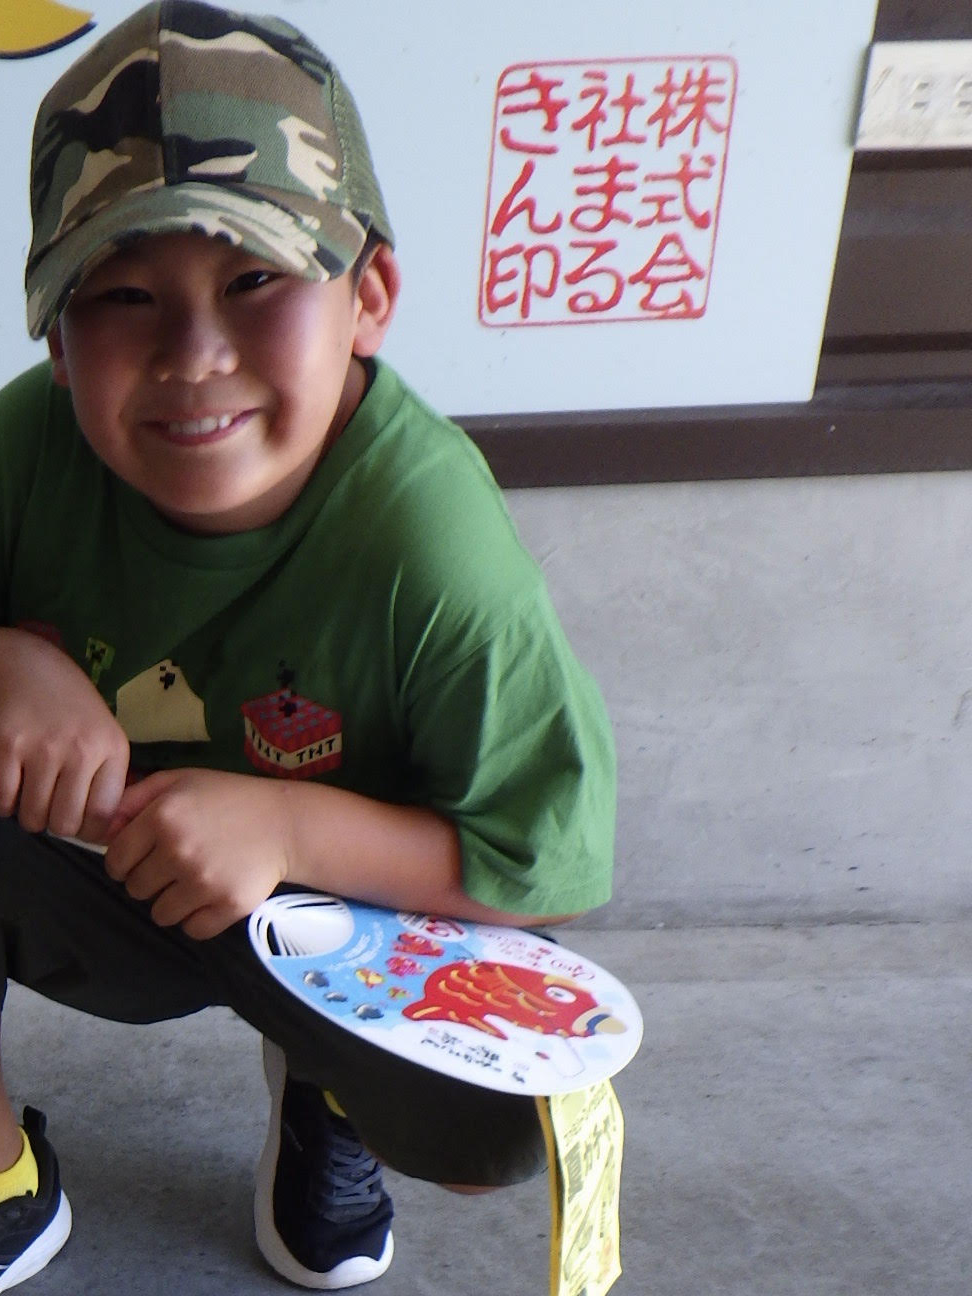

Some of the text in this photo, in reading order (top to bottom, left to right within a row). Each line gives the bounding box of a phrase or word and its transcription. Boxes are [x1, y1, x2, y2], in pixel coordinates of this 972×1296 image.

[485, 70, 569, 319] きん印
[564, 70, 648, 315] 社まる
[628, 66, 728, 319] 株式会
[297, 738, 336, 763] TNT
